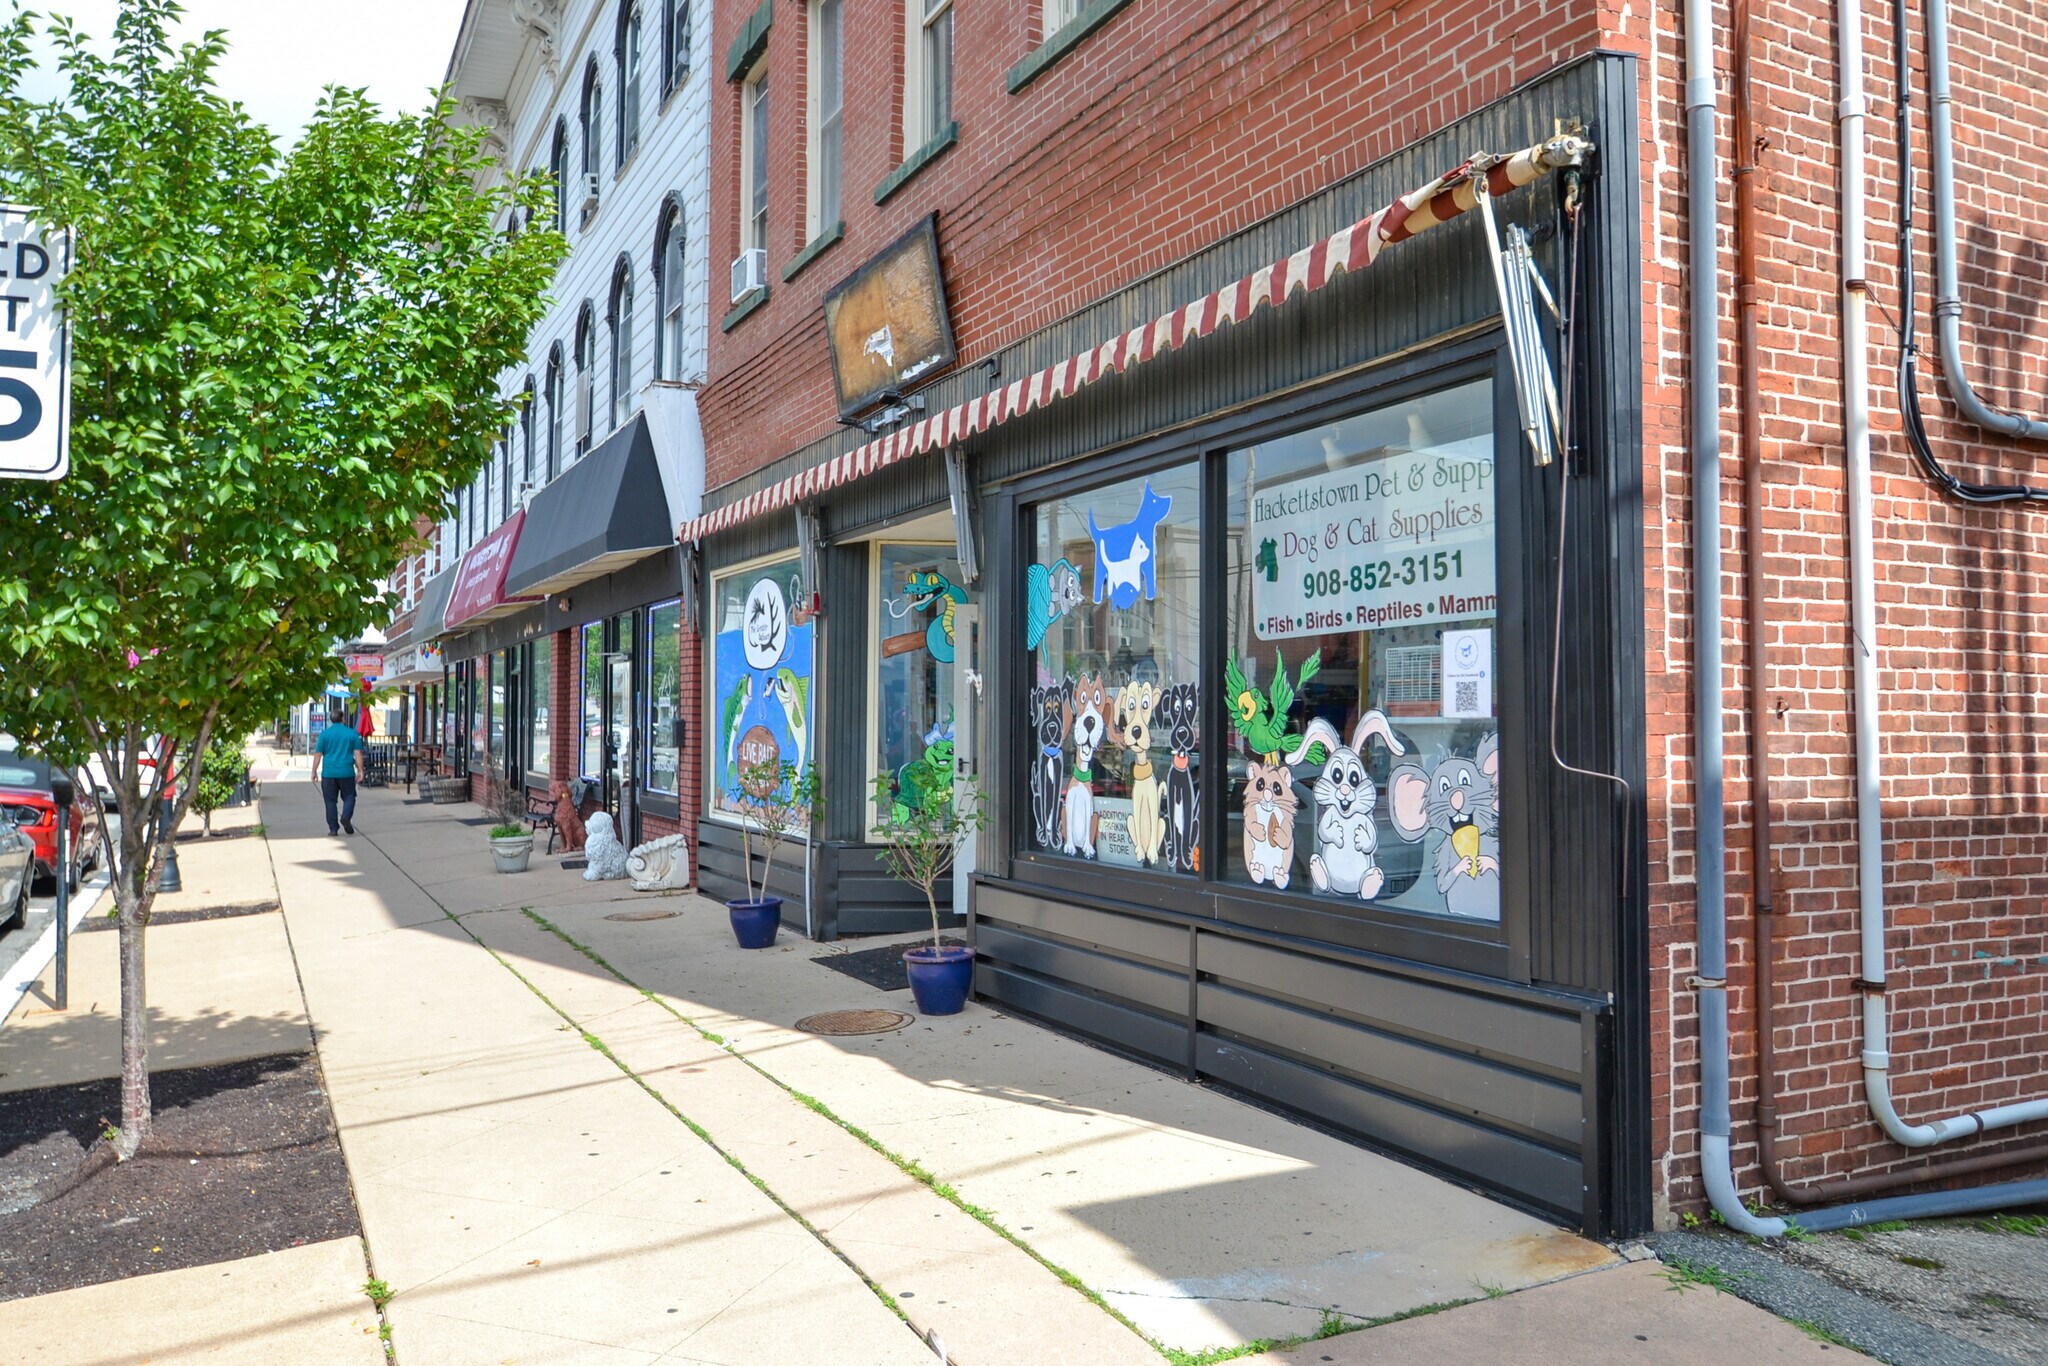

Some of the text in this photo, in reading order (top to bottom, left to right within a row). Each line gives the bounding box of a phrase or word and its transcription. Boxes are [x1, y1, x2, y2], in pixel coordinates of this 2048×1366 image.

[1254, 456, 1493, 523] Hackettstown Pet & Supp
[1283, 498, 1483, 563] Dog & Cat Supplies
[1303, 549, 1463, 599] 908-852-3151
[1267, 615, 1294, 635] Fish
[1305, 609, 1343, 630] Birds
[1356, 600, 1423, 627] Reptiles
[742, 741, 775, 765] LIVE BAIT
[1109, 833, 1125, 843] REAR
[1109, 843, 1129, 855] STORE
